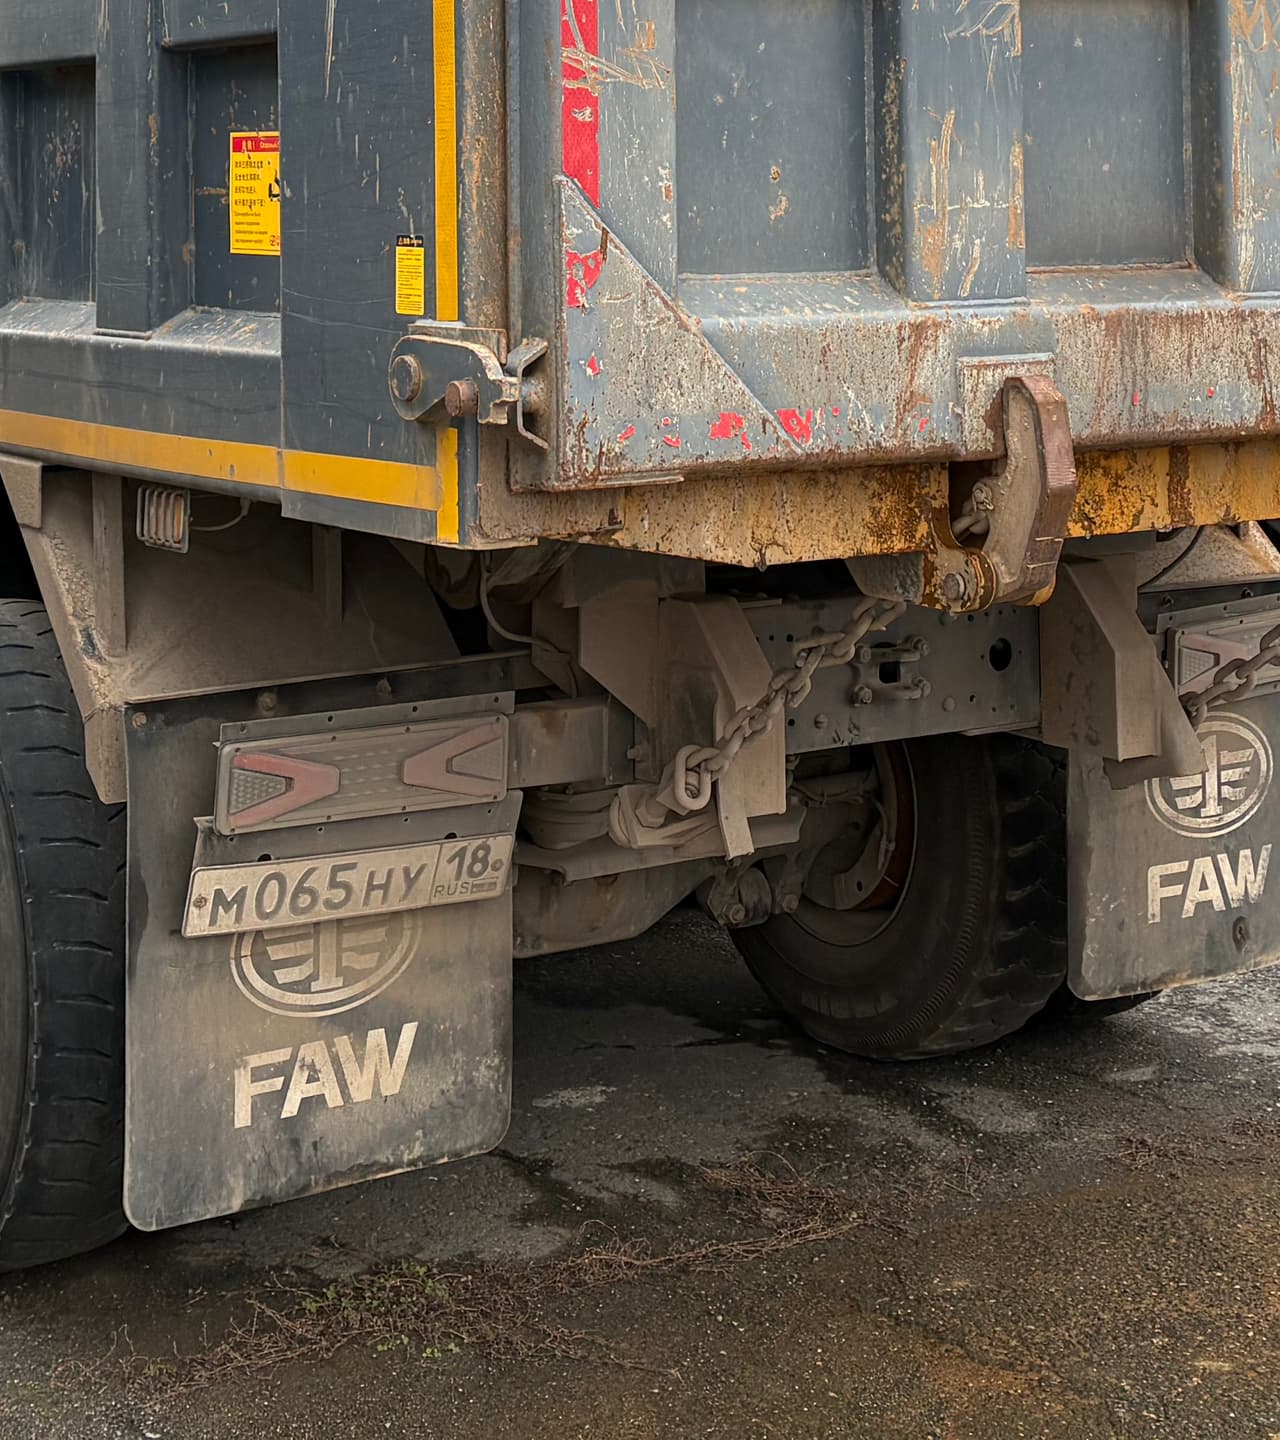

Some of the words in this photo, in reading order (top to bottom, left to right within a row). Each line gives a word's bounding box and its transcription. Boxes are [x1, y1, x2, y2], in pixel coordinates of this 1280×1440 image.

[434, 881, 470, 897] RUS
[446, 841, 492, 881] 18
[1147, 843, 1273, 924] FAW
[234, 1021, 419, 1129] FAW
